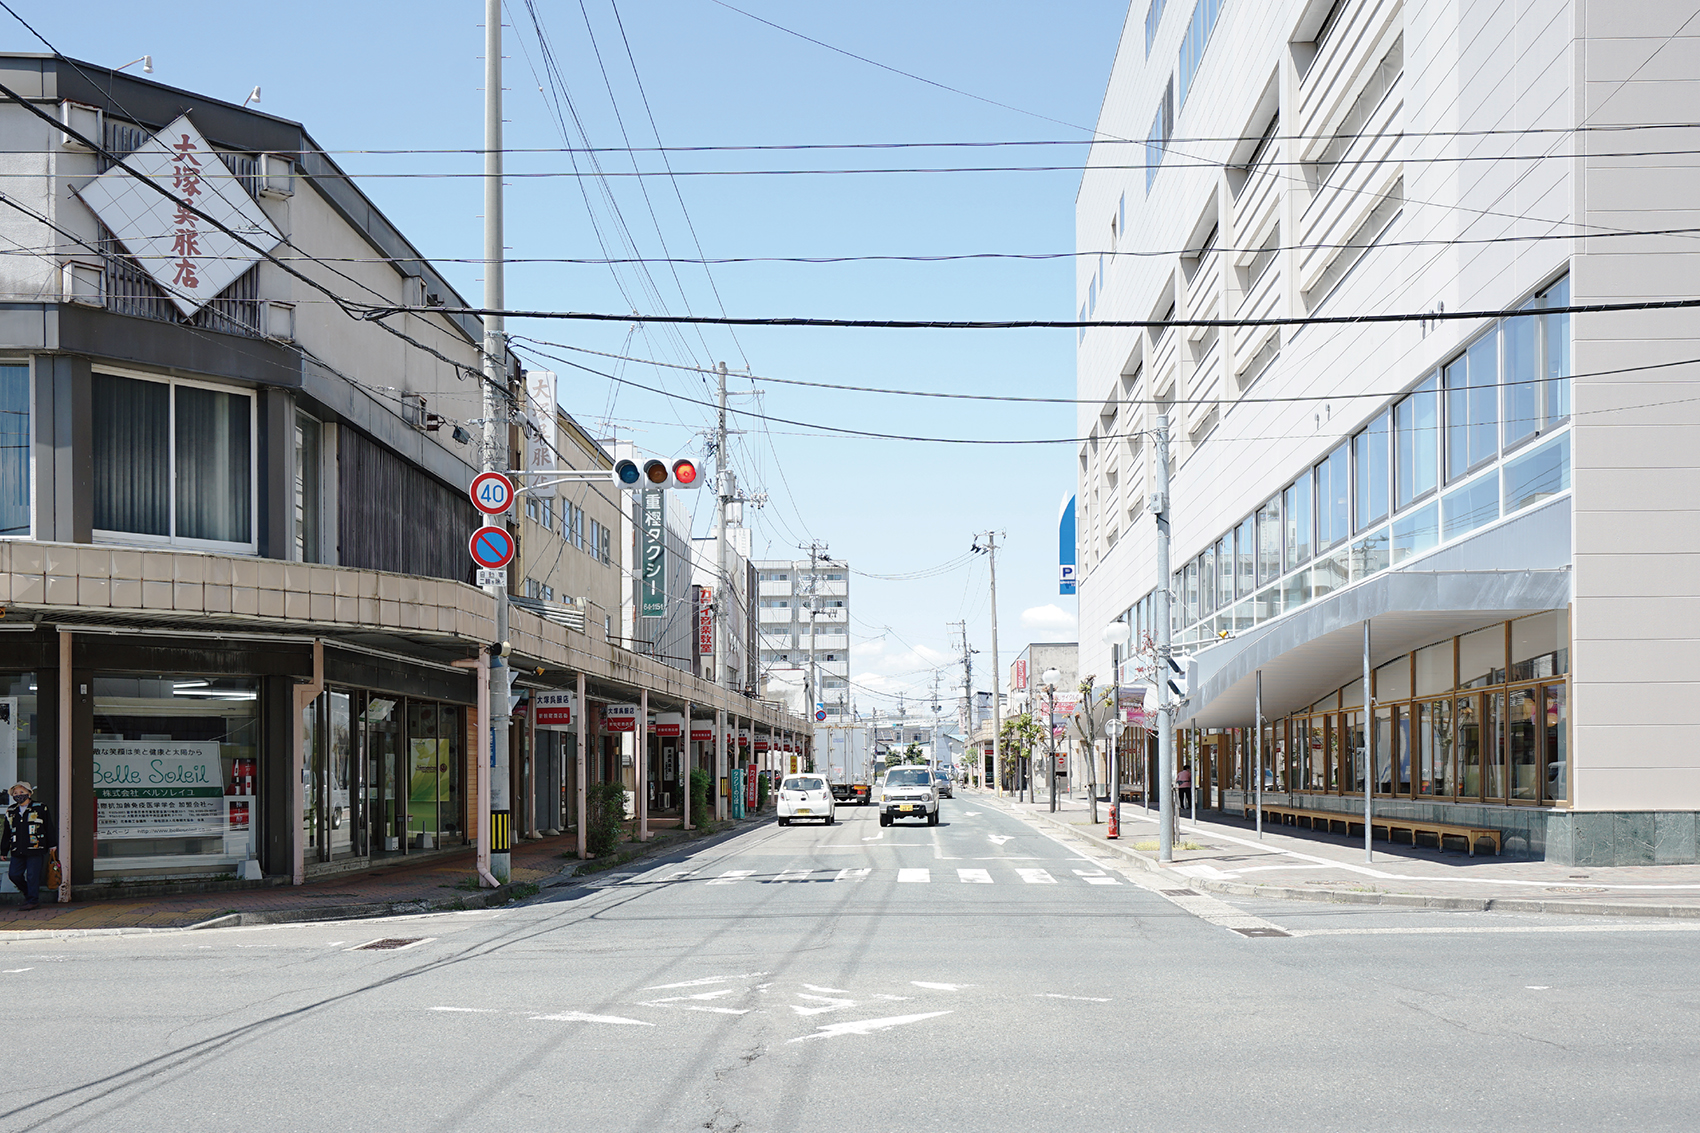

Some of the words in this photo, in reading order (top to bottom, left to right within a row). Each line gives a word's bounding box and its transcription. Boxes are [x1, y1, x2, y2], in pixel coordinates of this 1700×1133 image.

[171, 134, 202, 289] 大塚呉服店
[480, 485, 504, 503] 40
[644, 488, 662, 596] 重樫タクシー
[1062, 567, 1073, 578] P
[537, 695, 569, 704] 大塚呉服店
[93, 762, 142, 784] Belle
[149, 759, 209, 784] Soleil
[102, 789, 139, 798] 株式会社
